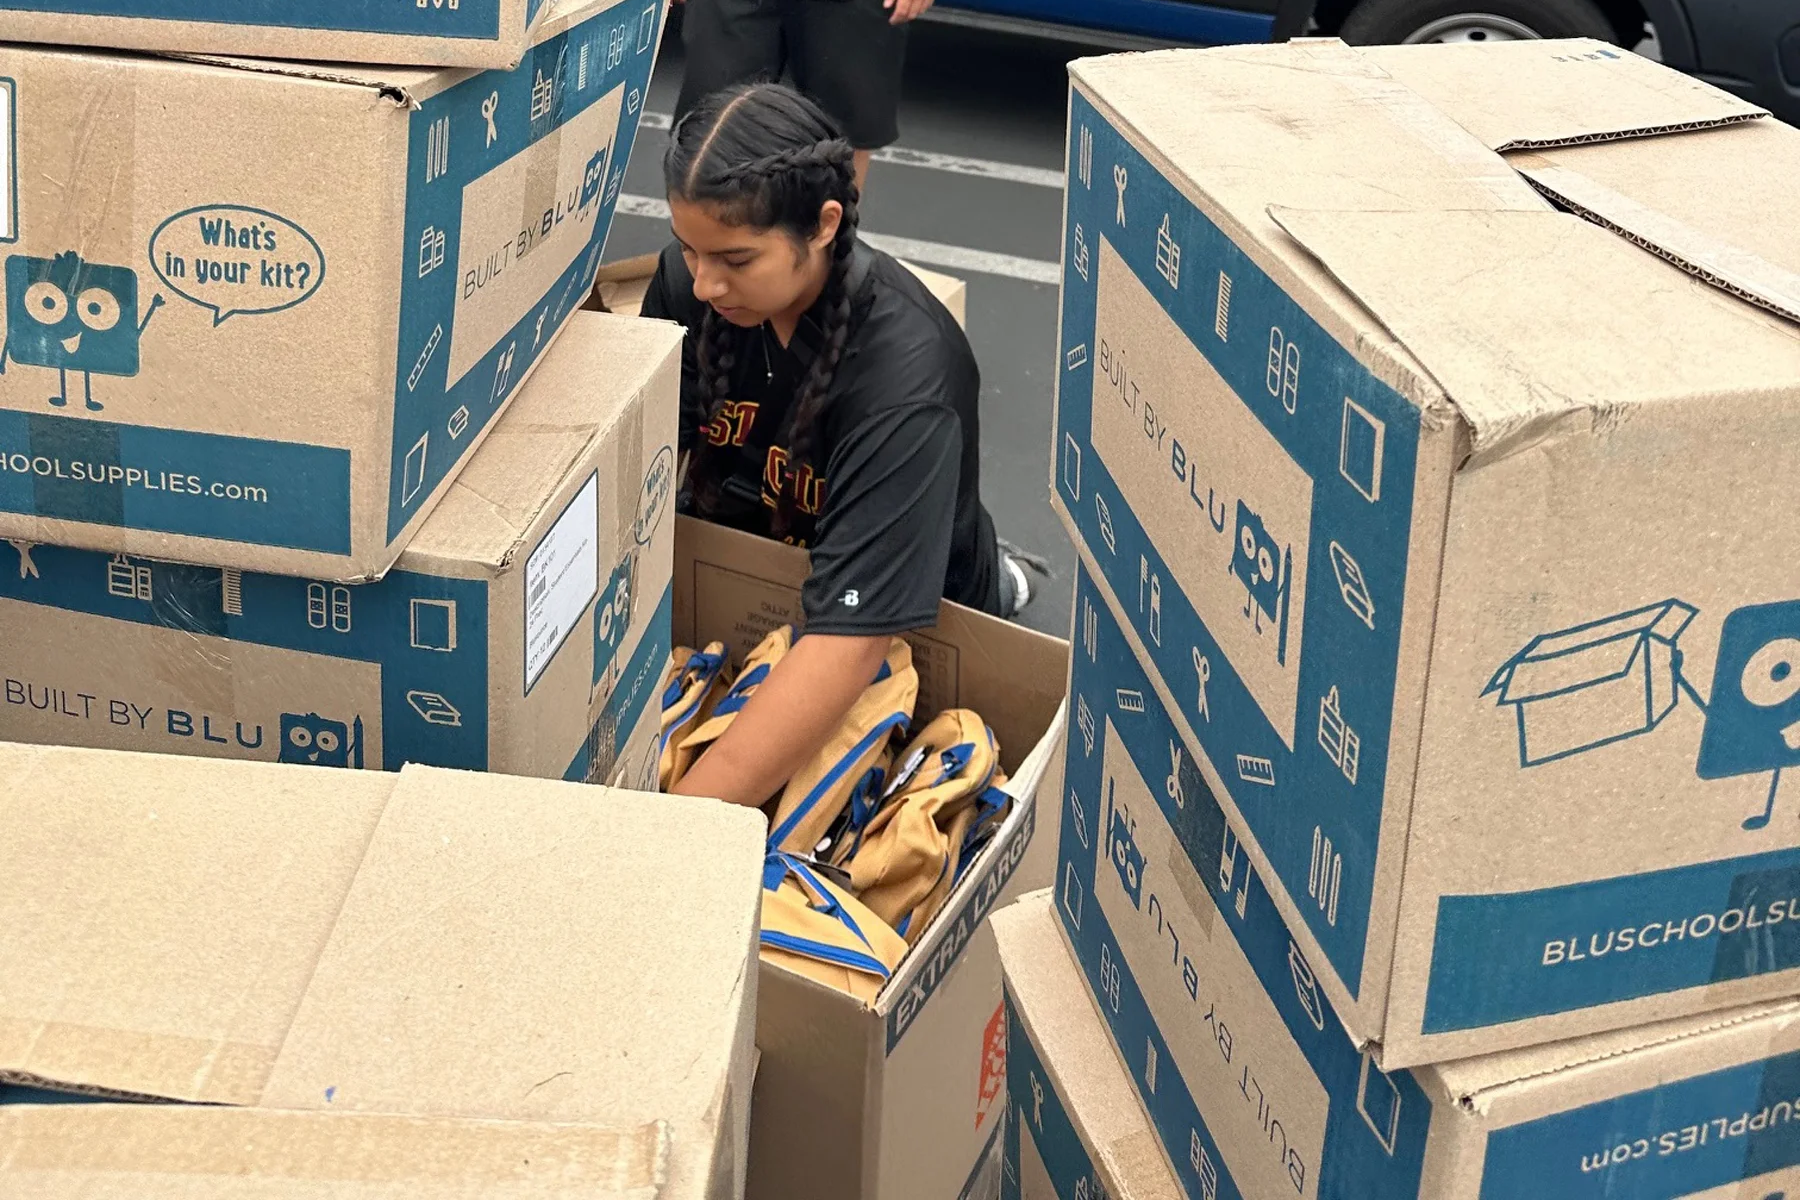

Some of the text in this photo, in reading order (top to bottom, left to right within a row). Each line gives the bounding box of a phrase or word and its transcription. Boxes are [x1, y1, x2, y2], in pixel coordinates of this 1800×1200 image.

[165, 251, 312, 290] in your kit?
[199, 216, 277, 251] What's
[463, 185, 579, 300] BUILT BY BLU
[1100, 338, 1226, 534] BUILT BY BLU
[5, 679, 263, 750] BUILT BY BLU
[895, 811, 1034, 1036] EXTRA LARGE
[1148, 893, 1306, 1195] BUILT BY BLU
[1579, 1098, 1800, 1173] UPPLIES.com
